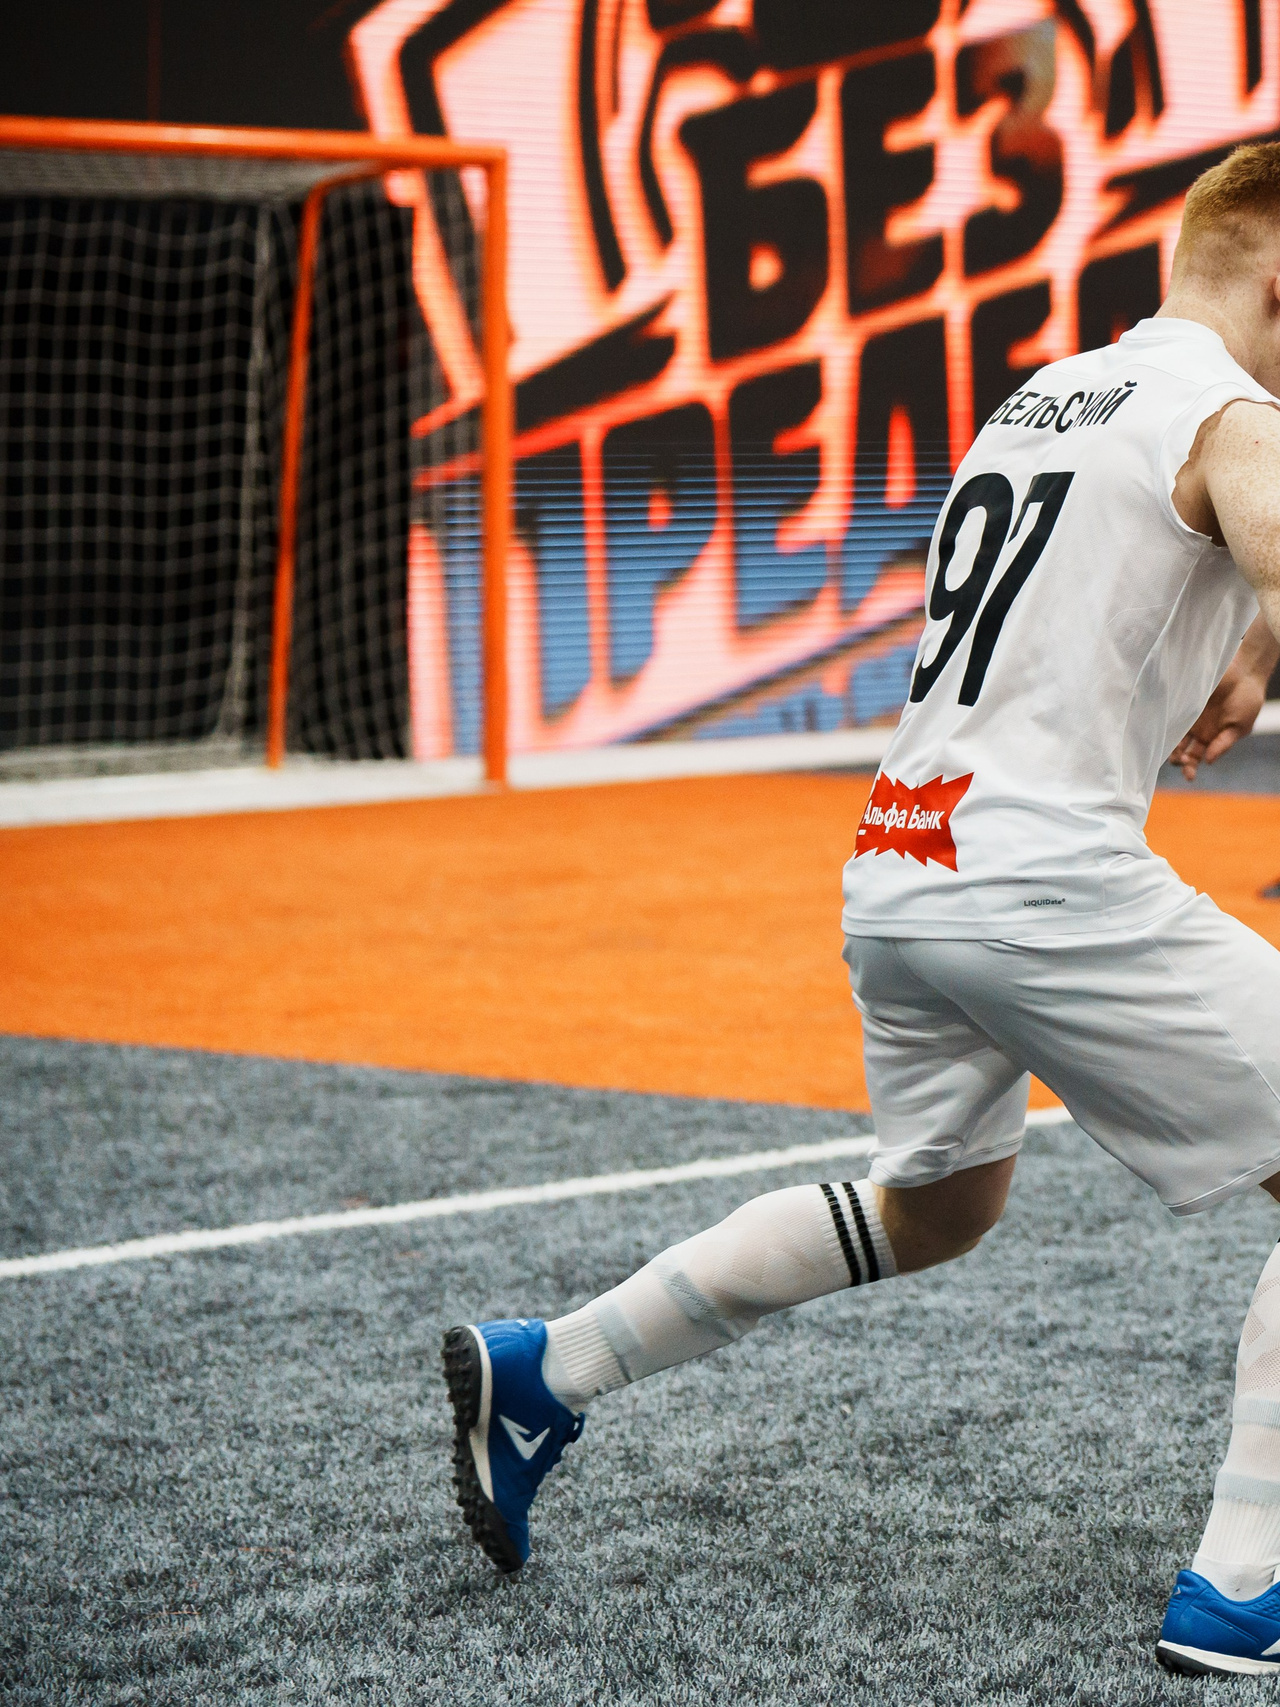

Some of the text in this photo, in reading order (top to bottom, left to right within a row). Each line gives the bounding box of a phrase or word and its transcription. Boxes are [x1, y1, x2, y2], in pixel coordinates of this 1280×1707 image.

[680, 25, 1066, 362] БЕЗ
[911, 471, 1075, 707] 97
[860, 800, 945, 835] Альфа Банк
